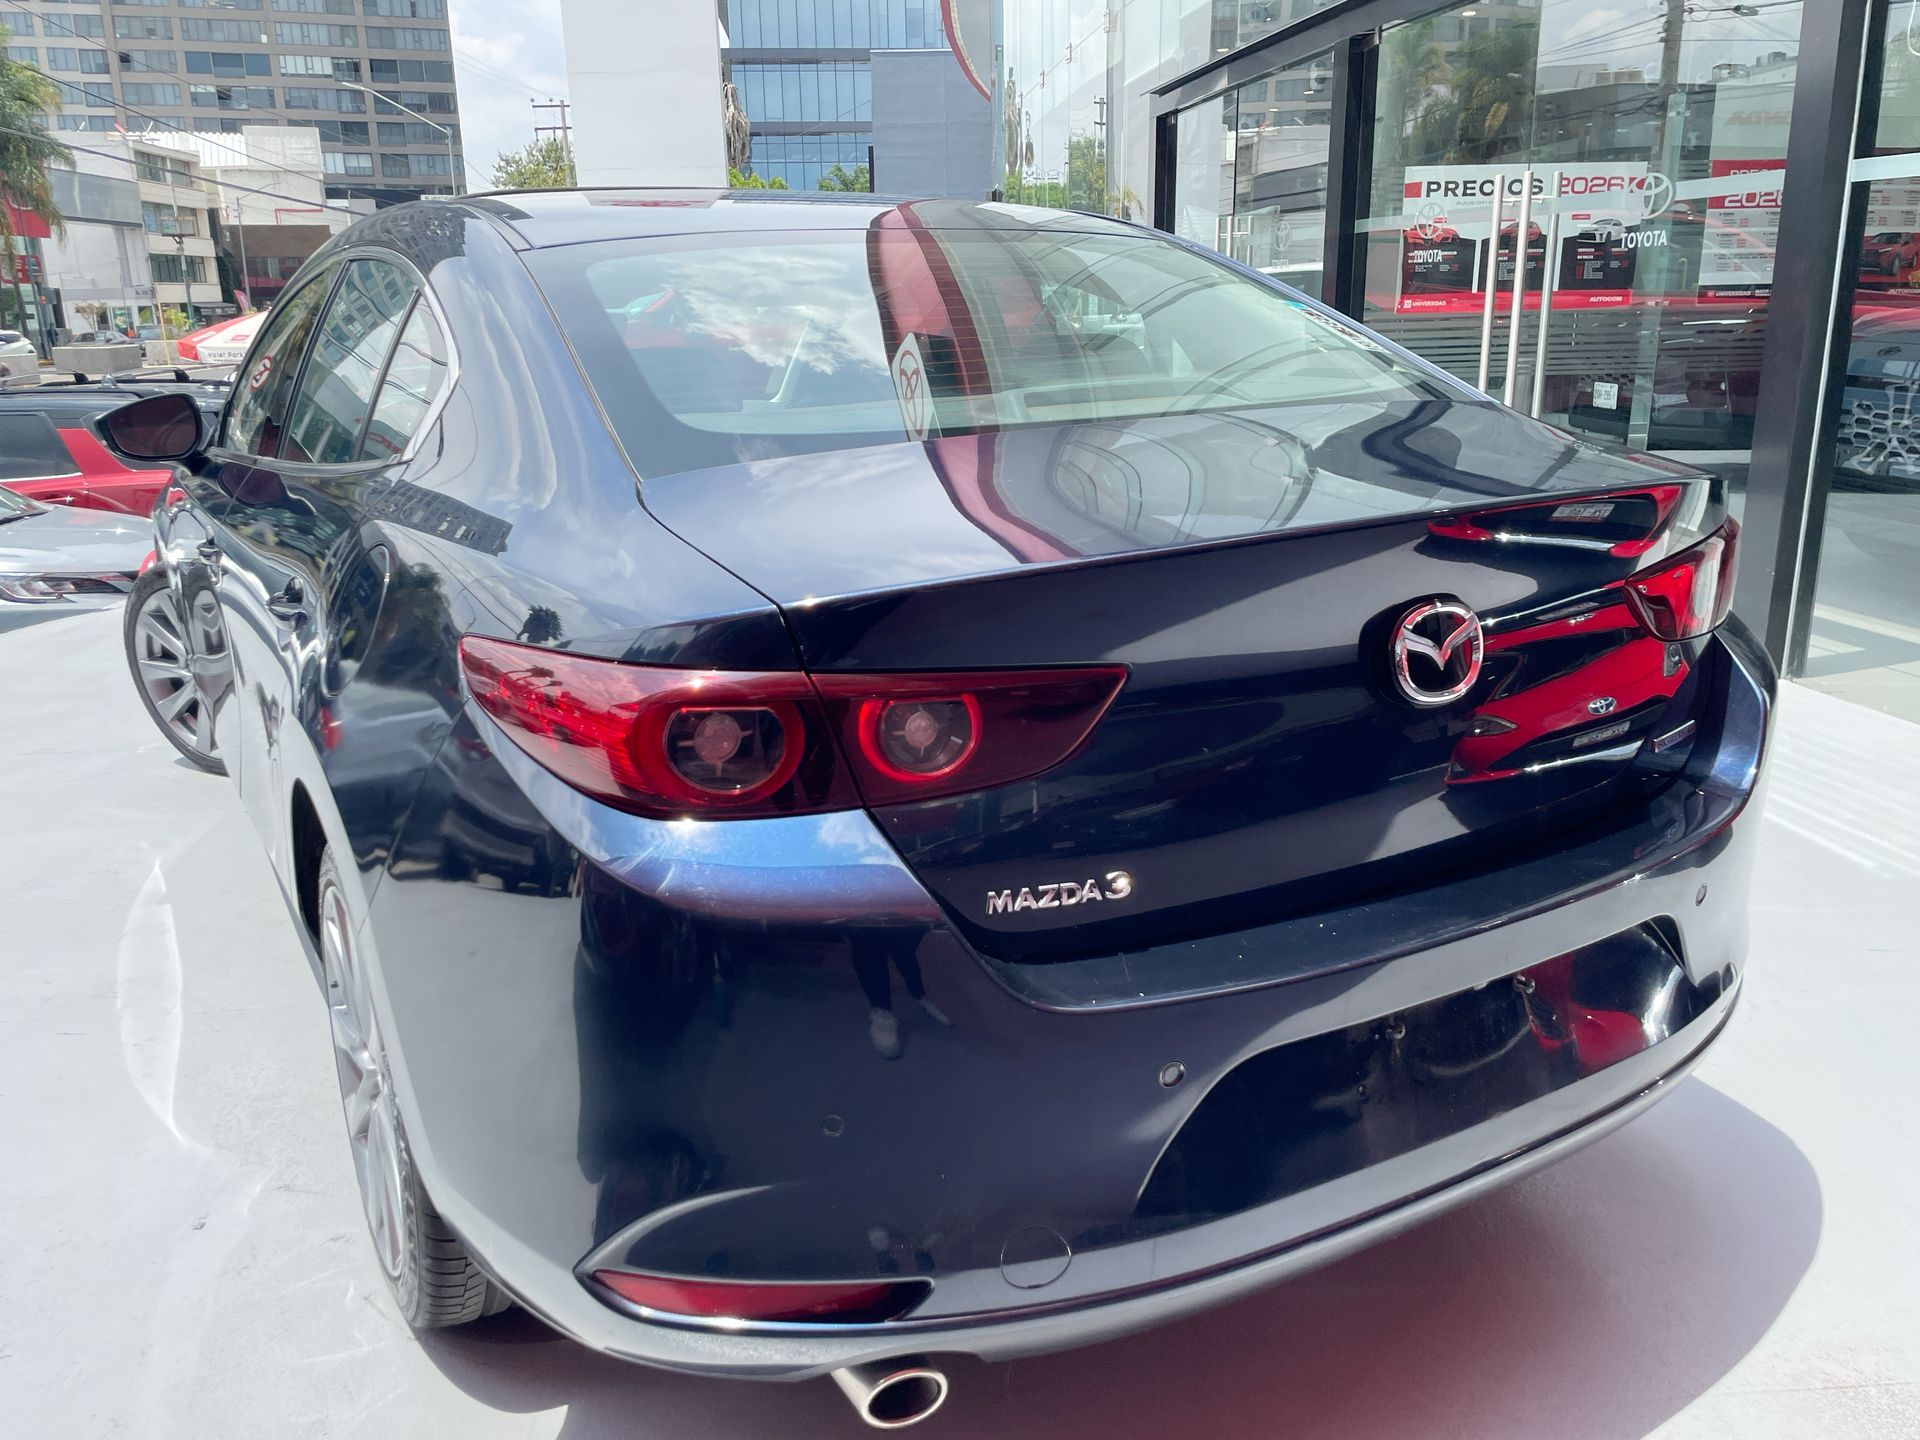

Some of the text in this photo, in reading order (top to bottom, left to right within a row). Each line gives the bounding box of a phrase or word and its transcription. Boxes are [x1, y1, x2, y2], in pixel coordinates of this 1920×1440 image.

[1425, 178, 1544, 198] PRECOS
[1621, 230, 1668, 249] TOYOTA
[1414, 249, 1443, 263] TOYOTA
